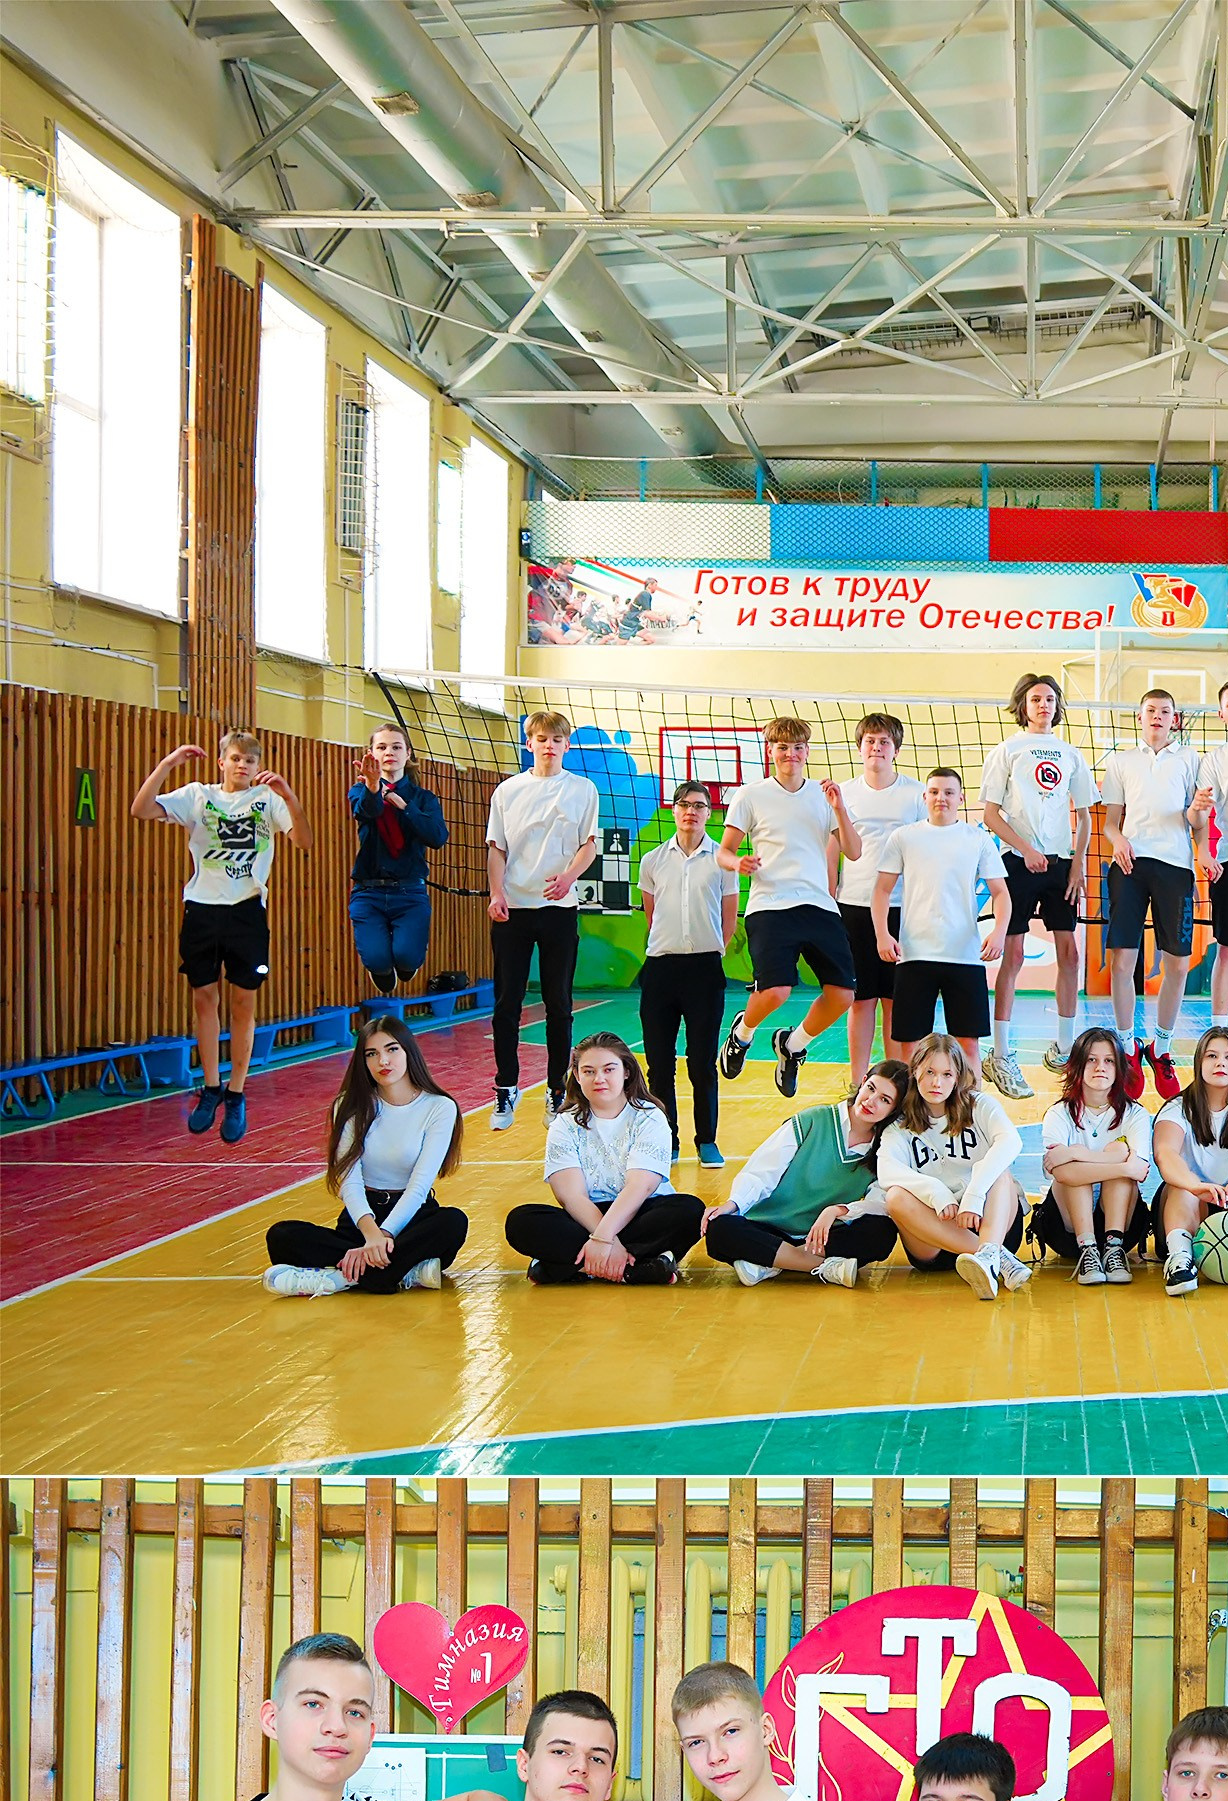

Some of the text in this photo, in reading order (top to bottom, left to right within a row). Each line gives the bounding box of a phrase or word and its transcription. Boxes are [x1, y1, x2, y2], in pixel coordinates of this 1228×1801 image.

[693, 569, 932, 603] Готов к труду
[736, 607, 758, 627] и
[769, 607, 906, 631] защите
[919, 602, 1115, 630] Отечества!
[77, 774, 95, 820] А
[428, 1622, 524, 1713] Гимназия
